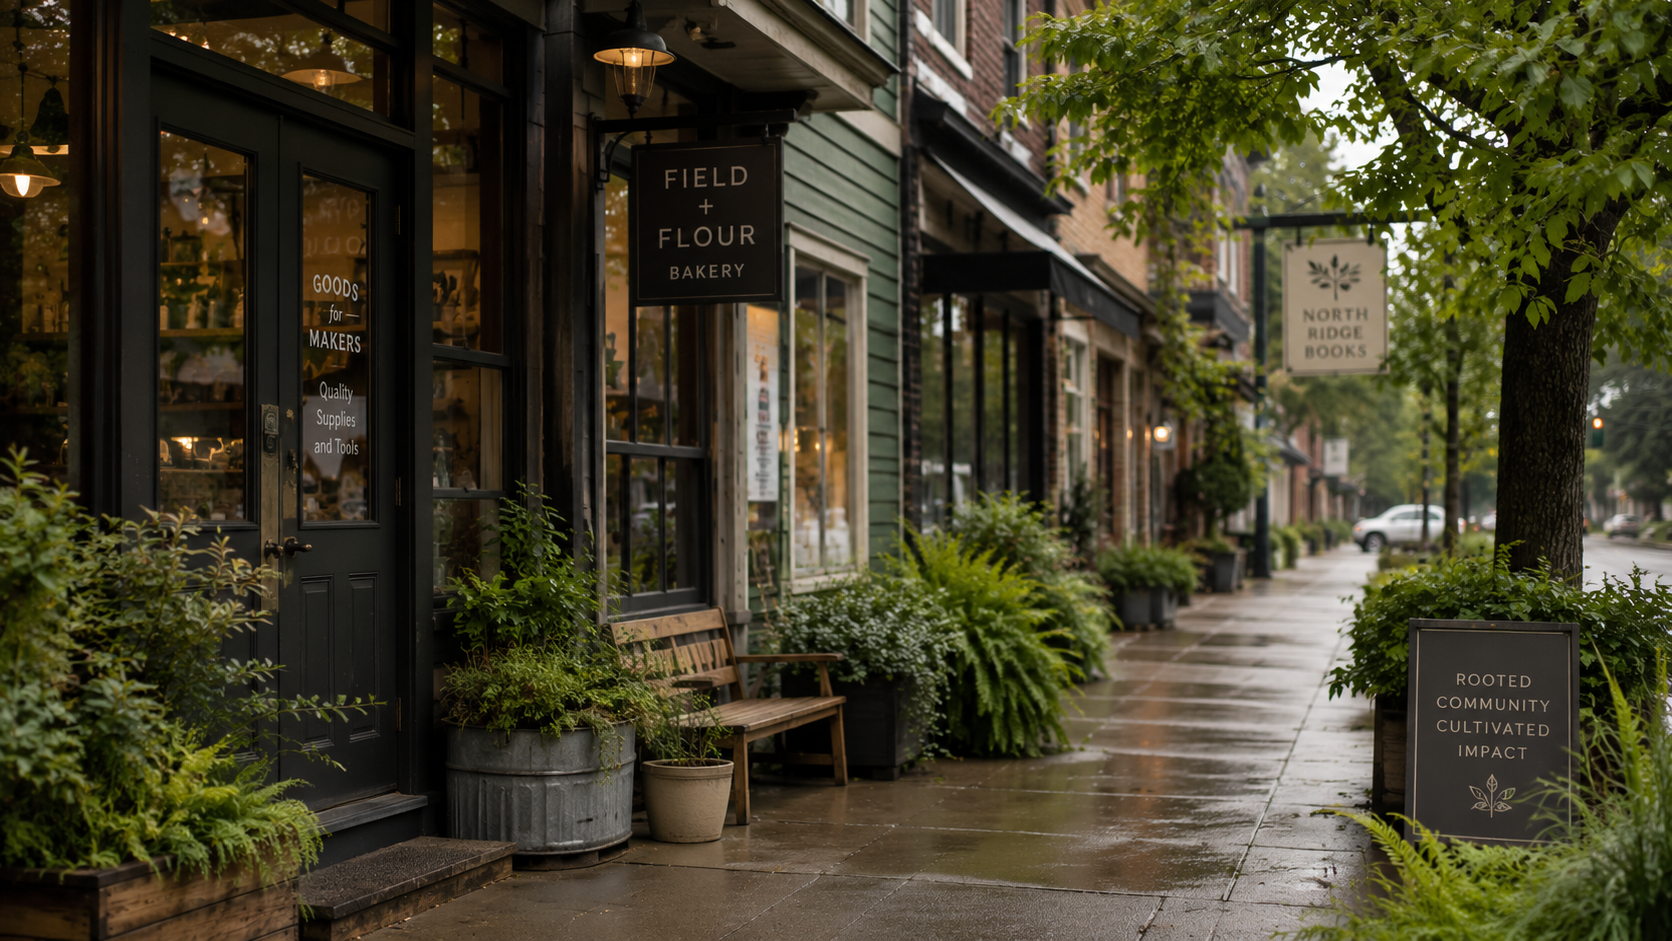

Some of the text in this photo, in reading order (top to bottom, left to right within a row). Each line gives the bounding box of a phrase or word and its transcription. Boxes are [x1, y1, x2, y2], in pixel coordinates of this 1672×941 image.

[665, 165, 748, 190] FIELD
[659, 224, 755, 249] FLOUR
[669, 263, 744, 280] BAKERY
[313, 273, 359, 302] GOODS
[328, 304, 343, 324] for
[1303, 307, 1368, 322] NORTH
[309, 328, 362, 353] MAKERS
[1308, 326, 1363, 340] RIDGE
[1305, 344, 1367, 359] BOOKS
[319, 381, 353, 405] Quality
[316, 408, 356, 430] Supplies
[314, 437, 359, 455] and Tools
[1456, 672, 1532, 688] ROOTED
[1436, 695, 1550, 713] COMMUNITY
[1436, 719, 1550, 737] CULTIVATED
[1458, 744, 1528, 760] IMPACT
